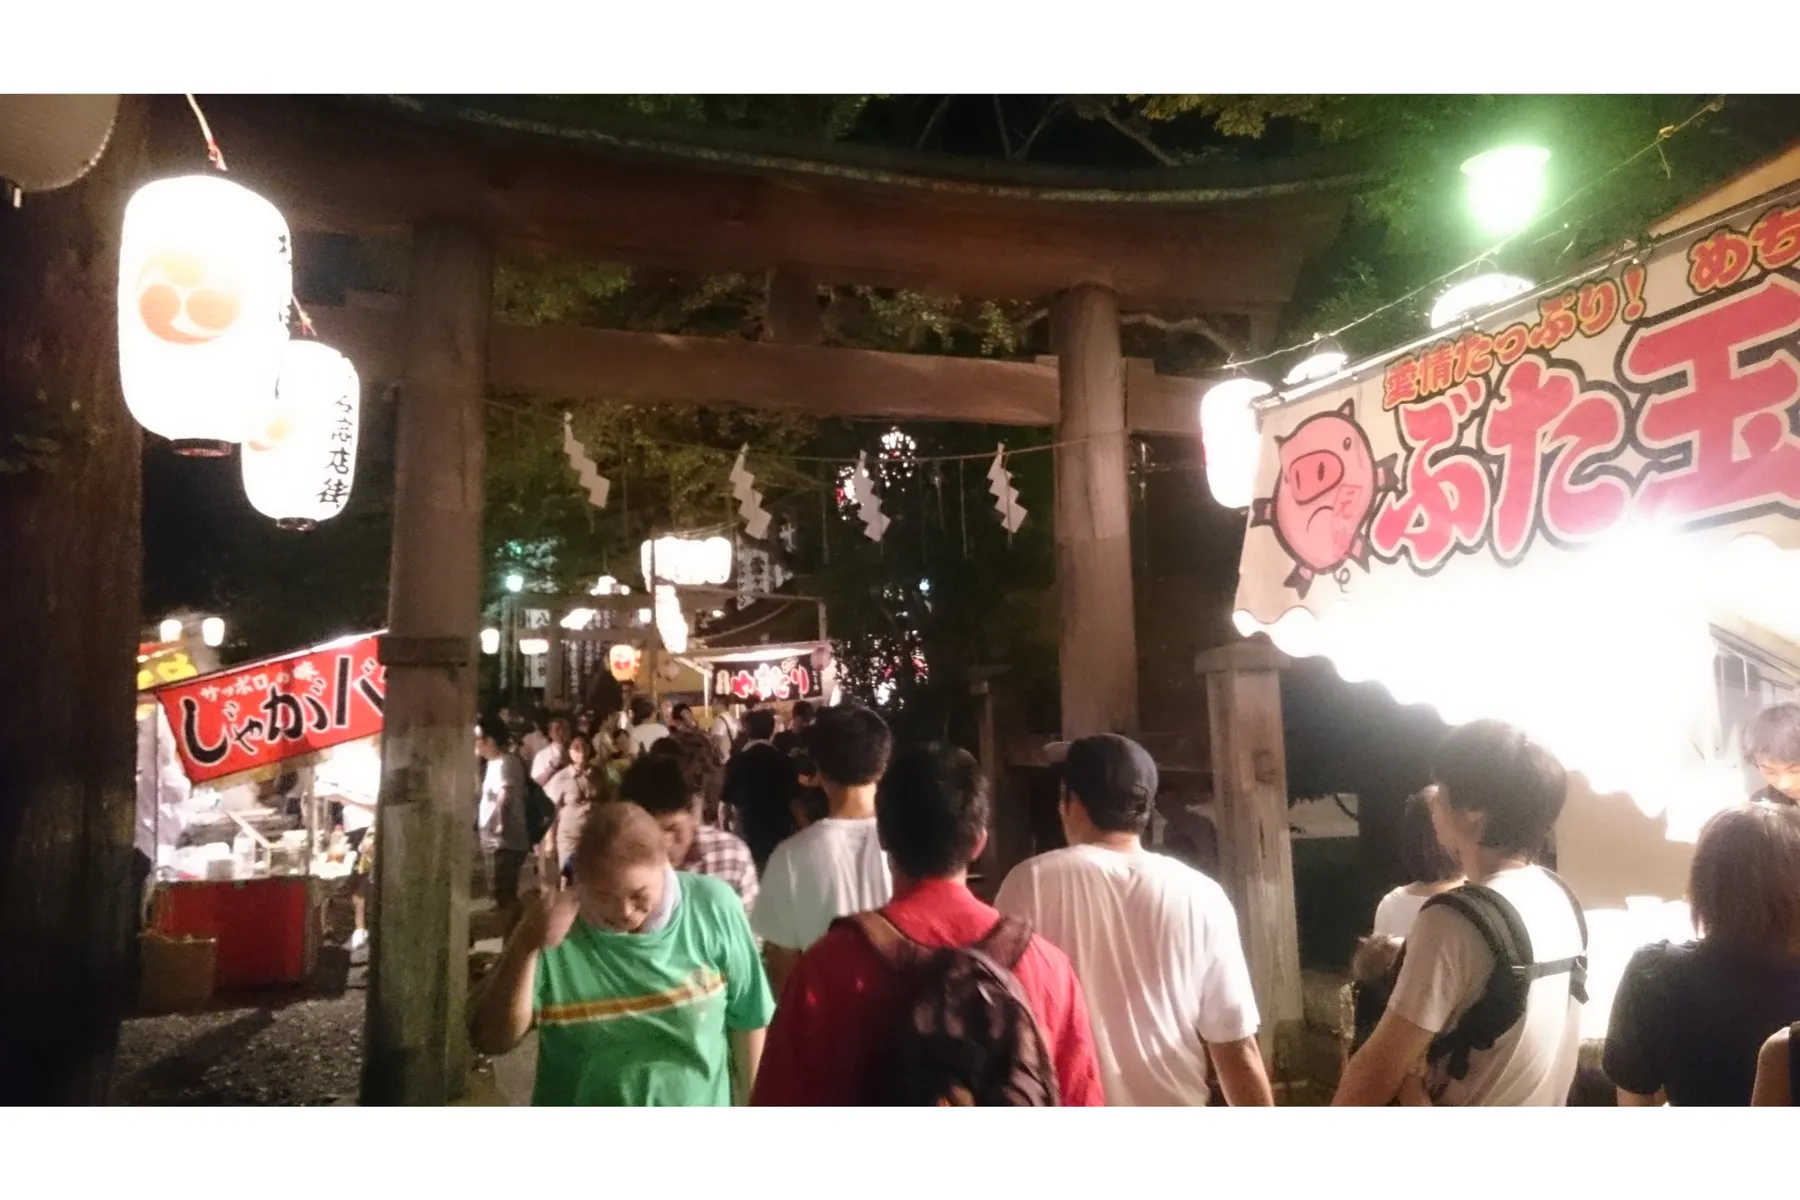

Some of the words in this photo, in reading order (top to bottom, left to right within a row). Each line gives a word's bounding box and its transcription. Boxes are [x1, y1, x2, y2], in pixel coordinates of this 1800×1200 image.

[1385, 264, 1647, 408] 愛情たっぷり！
